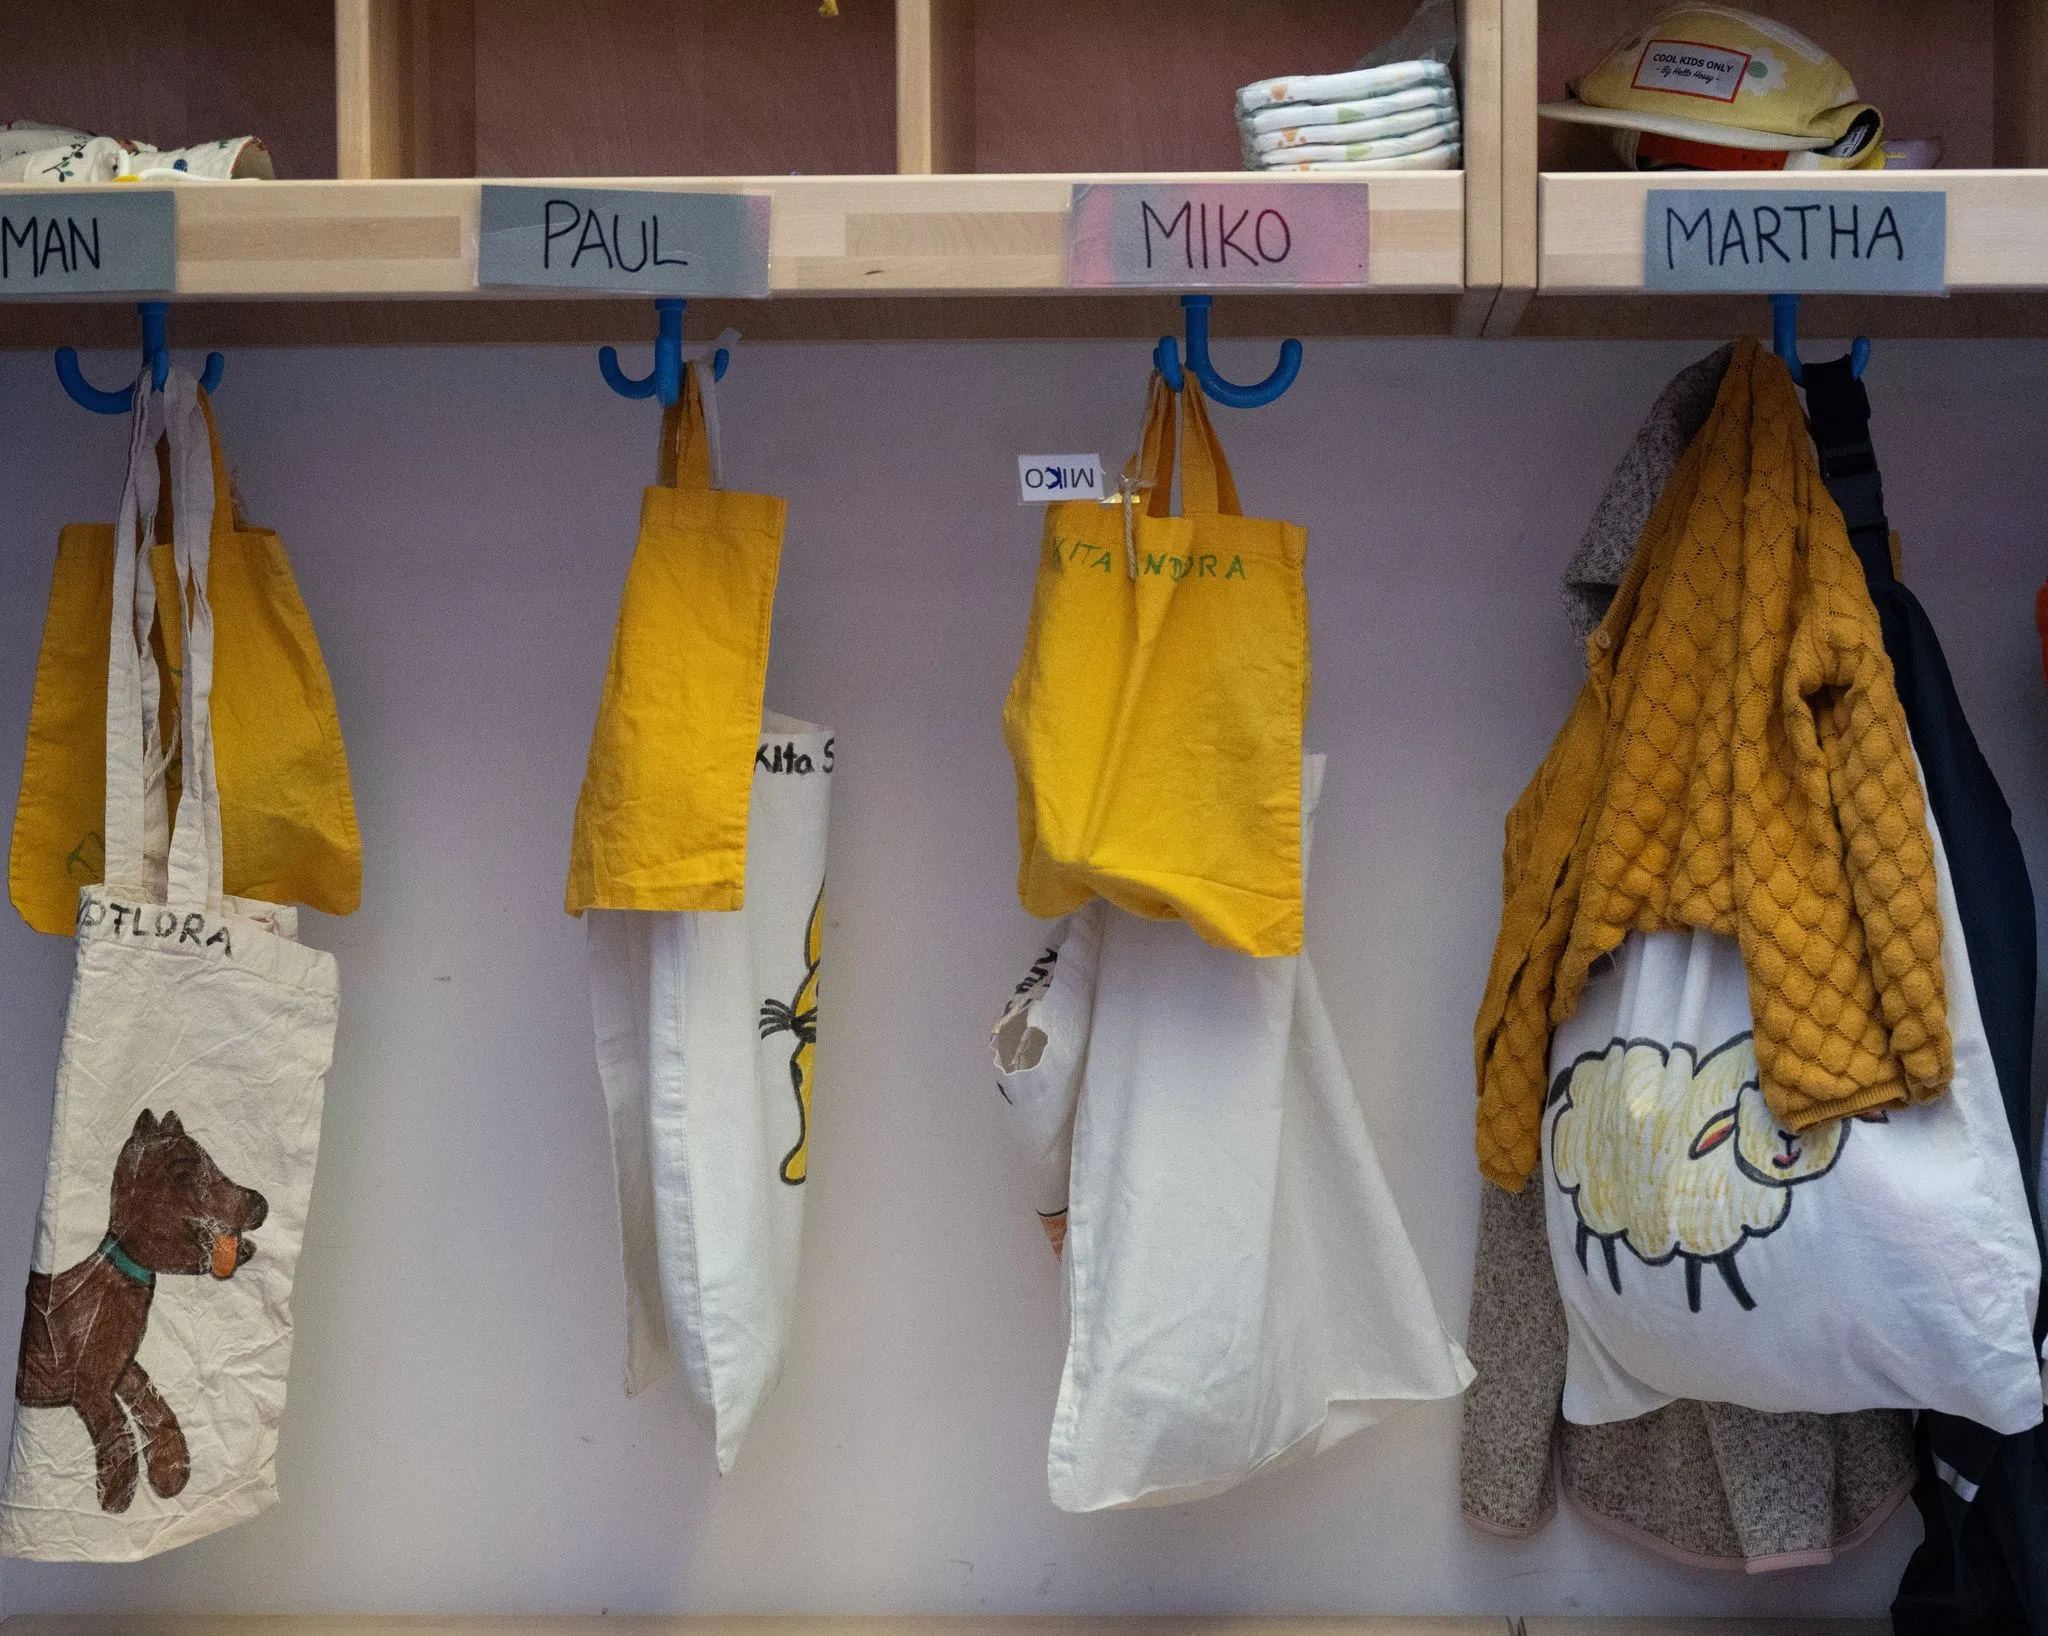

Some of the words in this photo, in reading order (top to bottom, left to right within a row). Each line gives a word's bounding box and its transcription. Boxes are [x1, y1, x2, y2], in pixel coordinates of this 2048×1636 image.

[1653, 53, 1677, 64] COOL
[1679, 56, 1704, 67] KIDS
[1706, 61, 1734, 73] ONLY
[1660, 65, 1671, 77] By
[1672, 67, 1692, 77] Hello
[1, 216, 100, 278] MAN
[545, 200, 689, 272] PAUL
[1142, 201, 1290, 269] MIKO
[1667, 204, 1903, 270] MARTHA
[1025, 467, 1094, 489] MIKO
